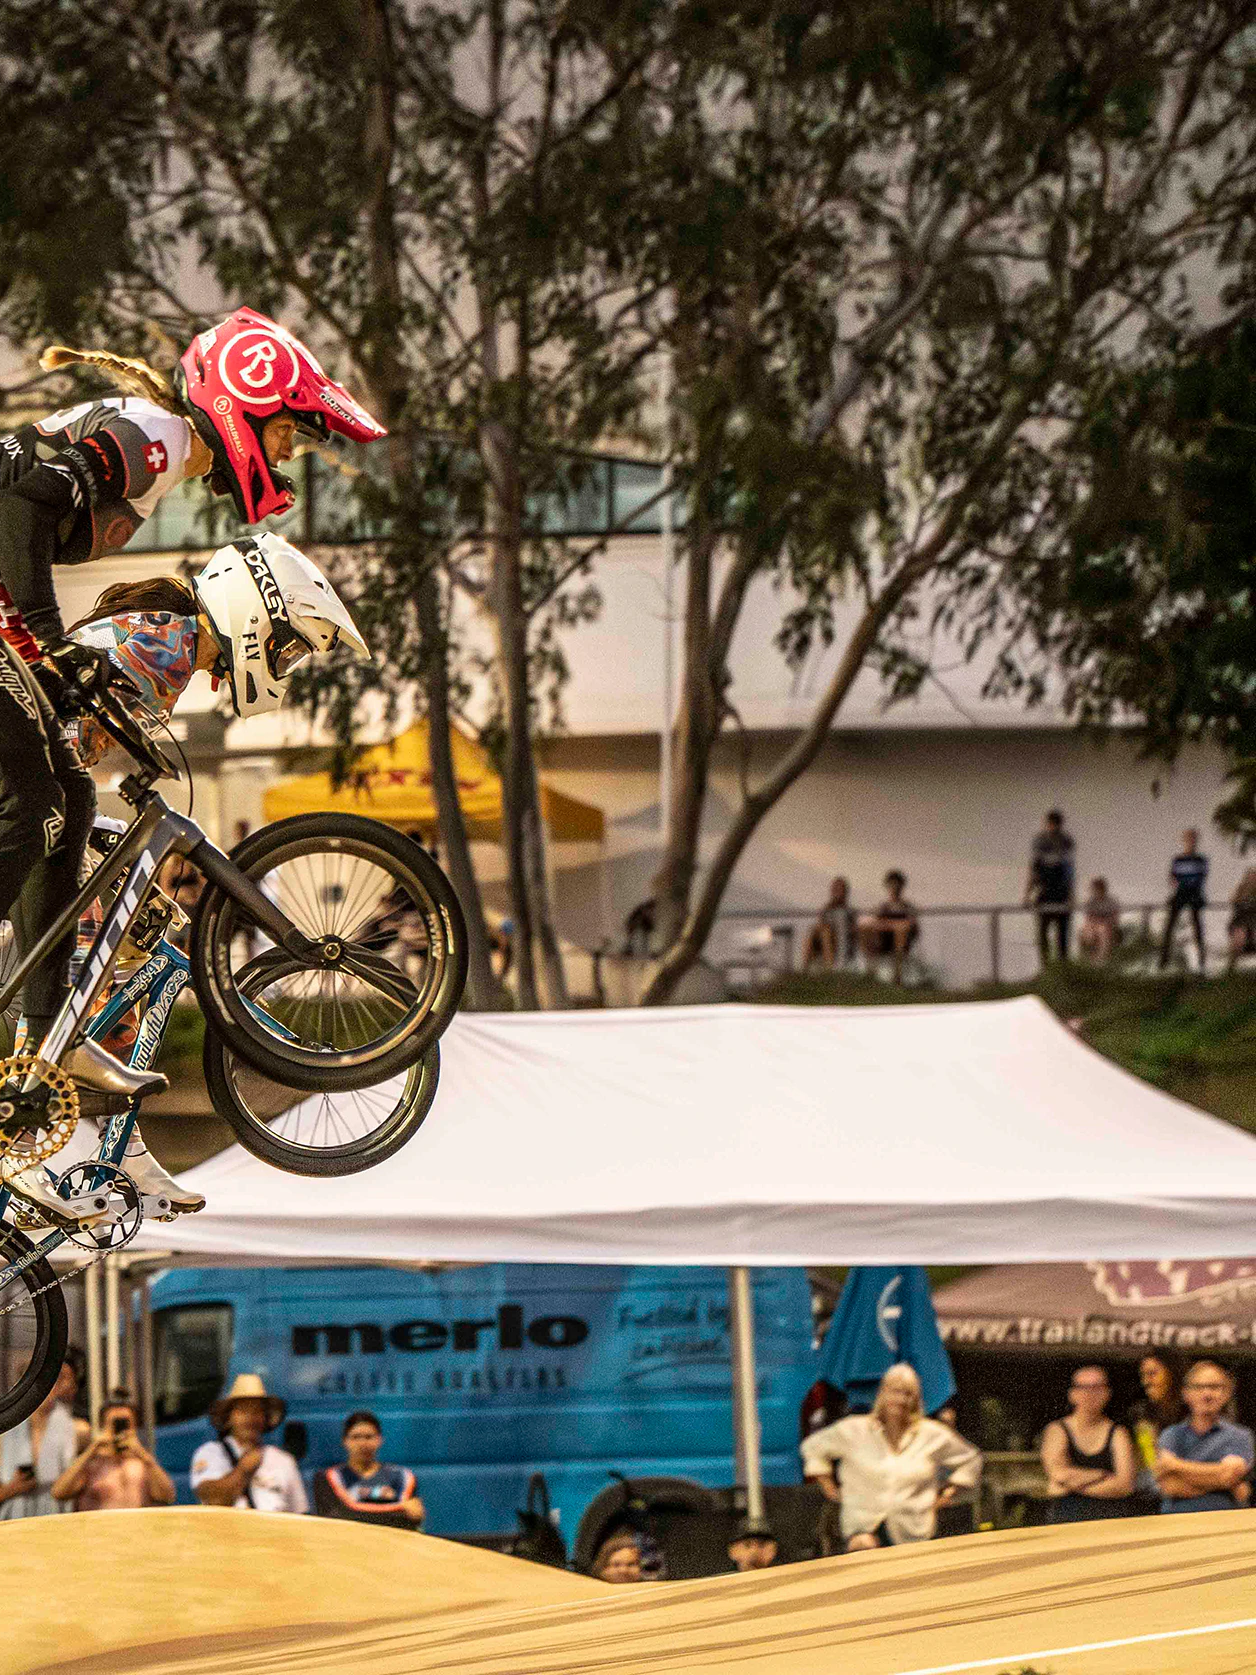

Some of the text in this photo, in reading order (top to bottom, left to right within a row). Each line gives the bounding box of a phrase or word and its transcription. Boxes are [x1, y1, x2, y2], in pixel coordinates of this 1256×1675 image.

[244, 550, 289, 621] OAKLEY
[242, 631, 261, 661] FLY
[292, 1304, 589, 1357] merlo
